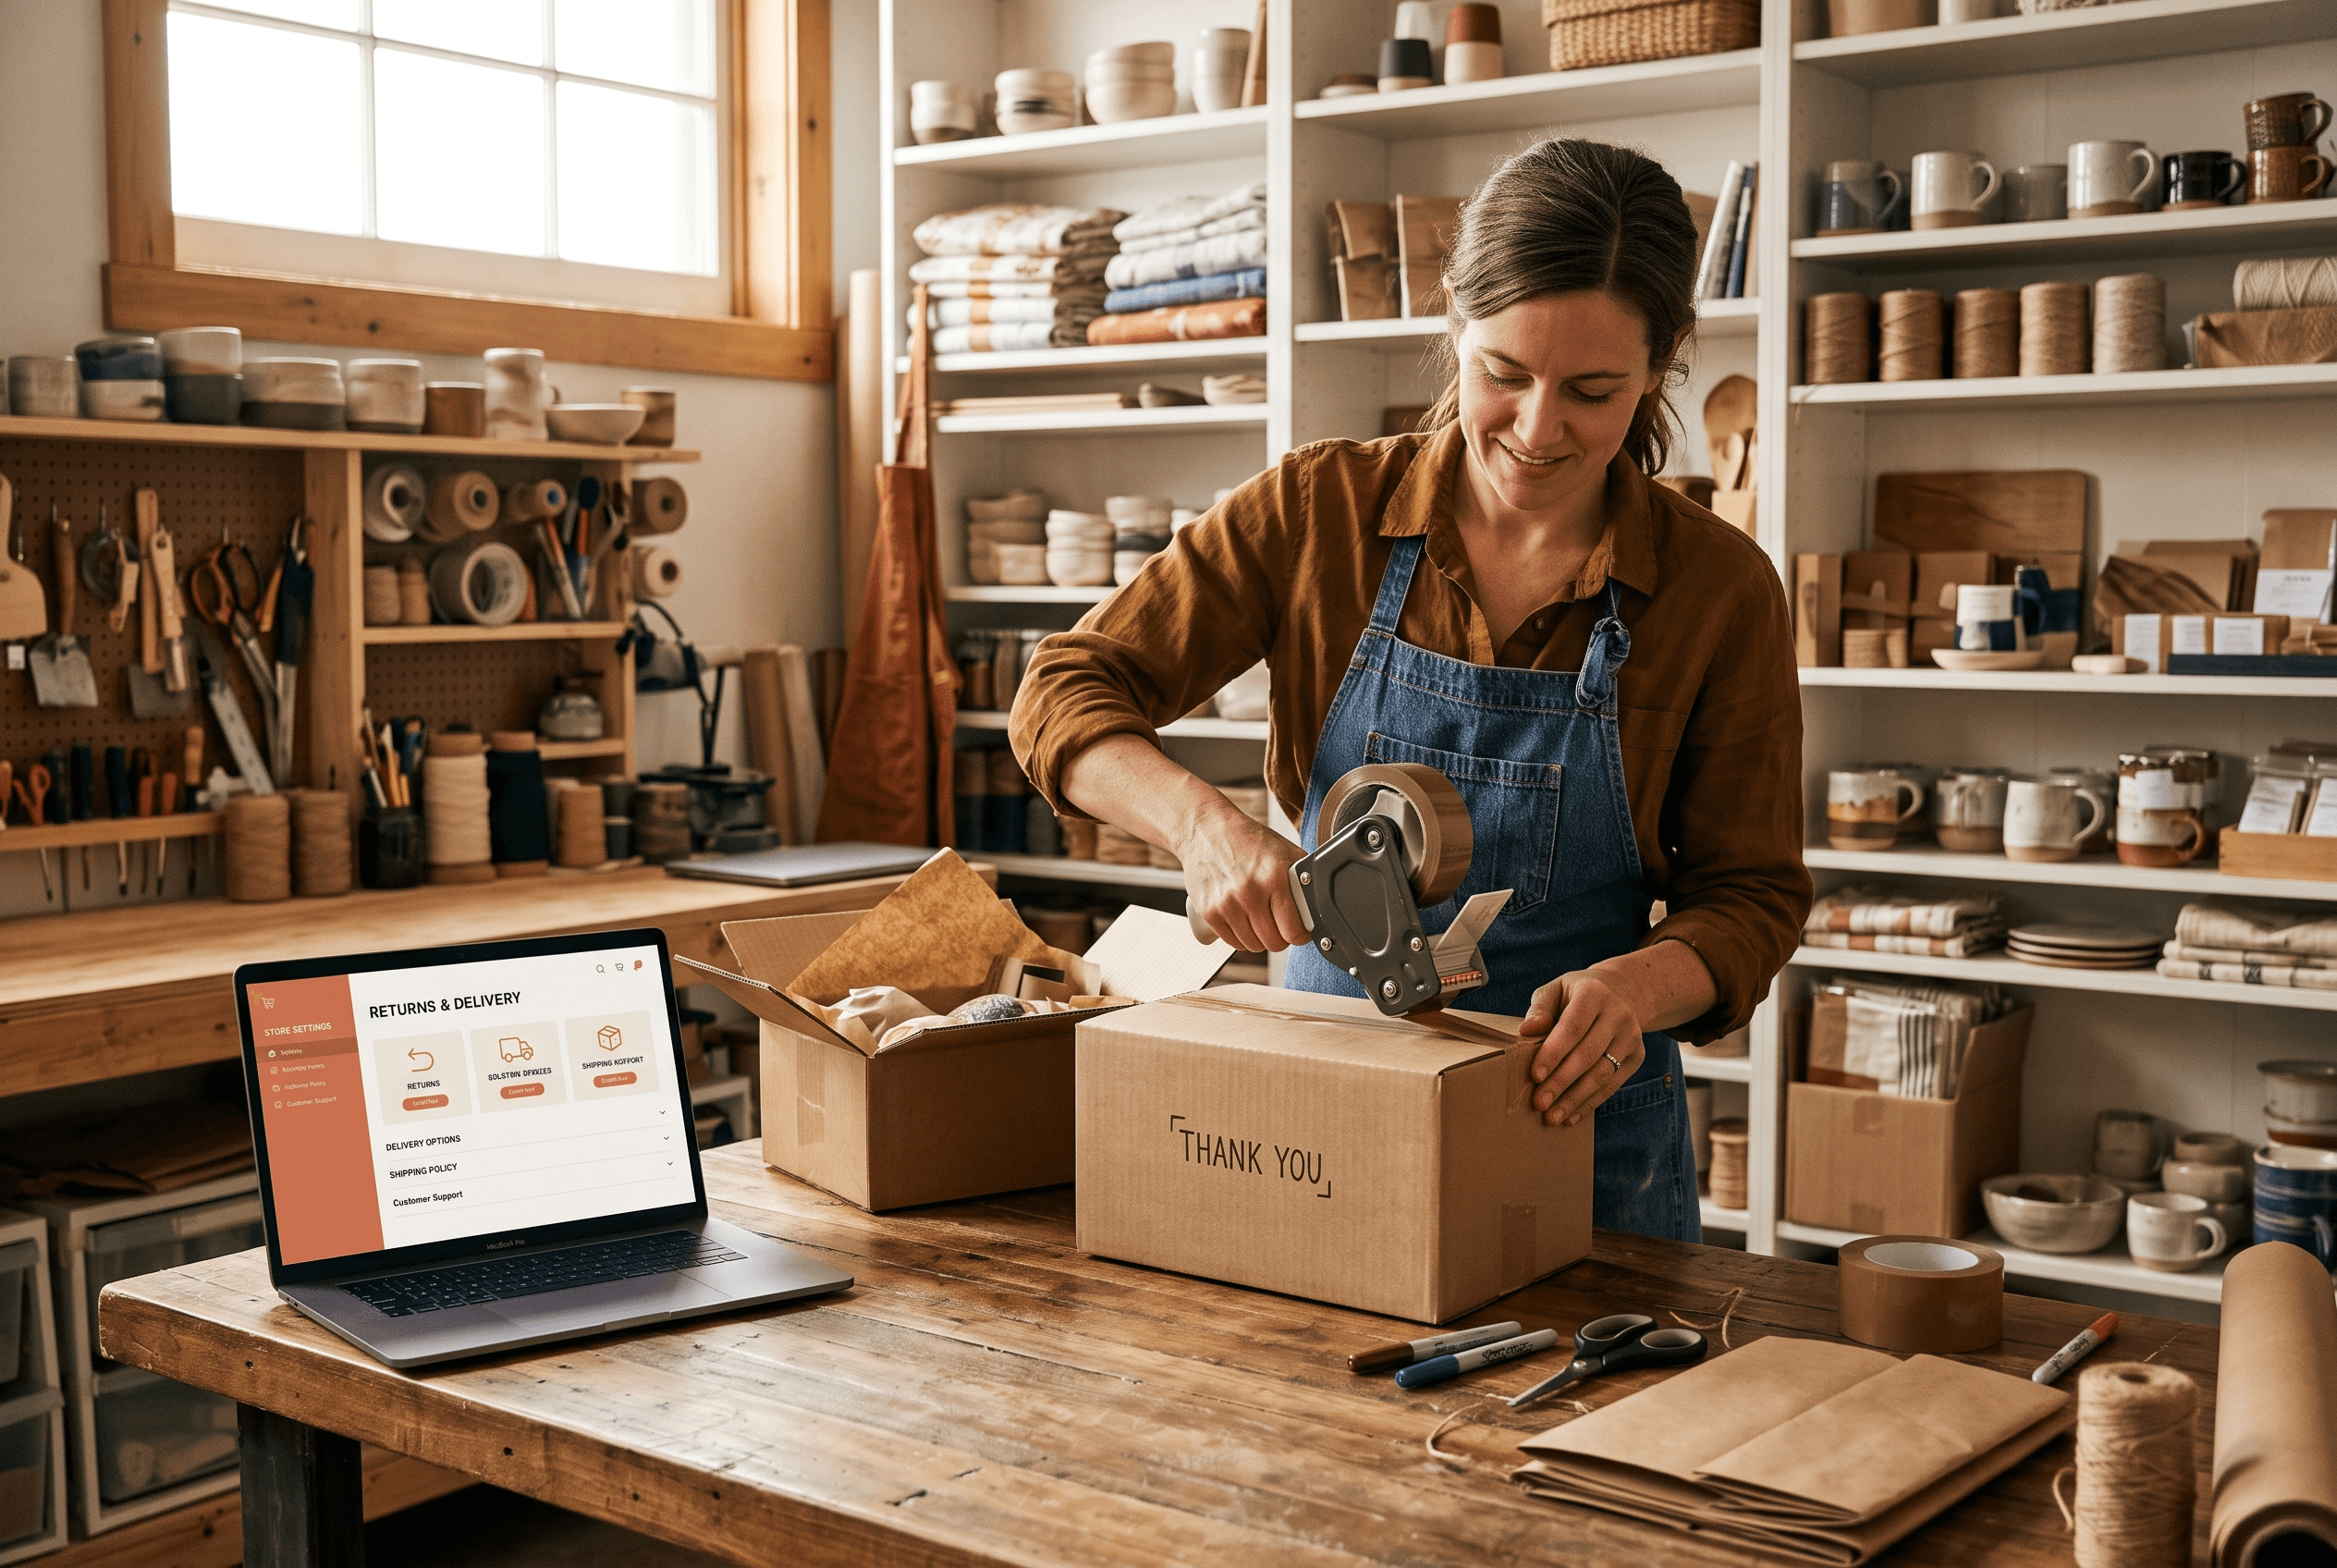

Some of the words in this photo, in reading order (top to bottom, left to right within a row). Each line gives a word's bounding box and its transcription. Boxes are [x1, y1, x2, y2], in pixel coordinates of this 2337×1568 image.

[369, 1000, 436, 1019] RETURNS
[440, 998, 451, 1011] &
[454, 991, 521, 1011] DELIVERY
[264, 1026, 291, 1036] STORE
[292, 1022, 332, 1034] SETTINGS
[581, 1060, 613, 1070] SHIPPING
[407, 1080, 441, 1091] RETURNS
[385, 1139, 424, 1152] DELIVERY
[425, 1134, 461, 1146] OPTIONS
[1179, 1129, 1263, 1175] THANK
[1274, 1145, 1322, 1184] YOU
[389, 1167, 428, 1179] SHIPPING
[429, 1162, 458, 1174] POLICY
[393, 1195, 431, 1207] Customer
[433, 1190, 463, 1203] Support
